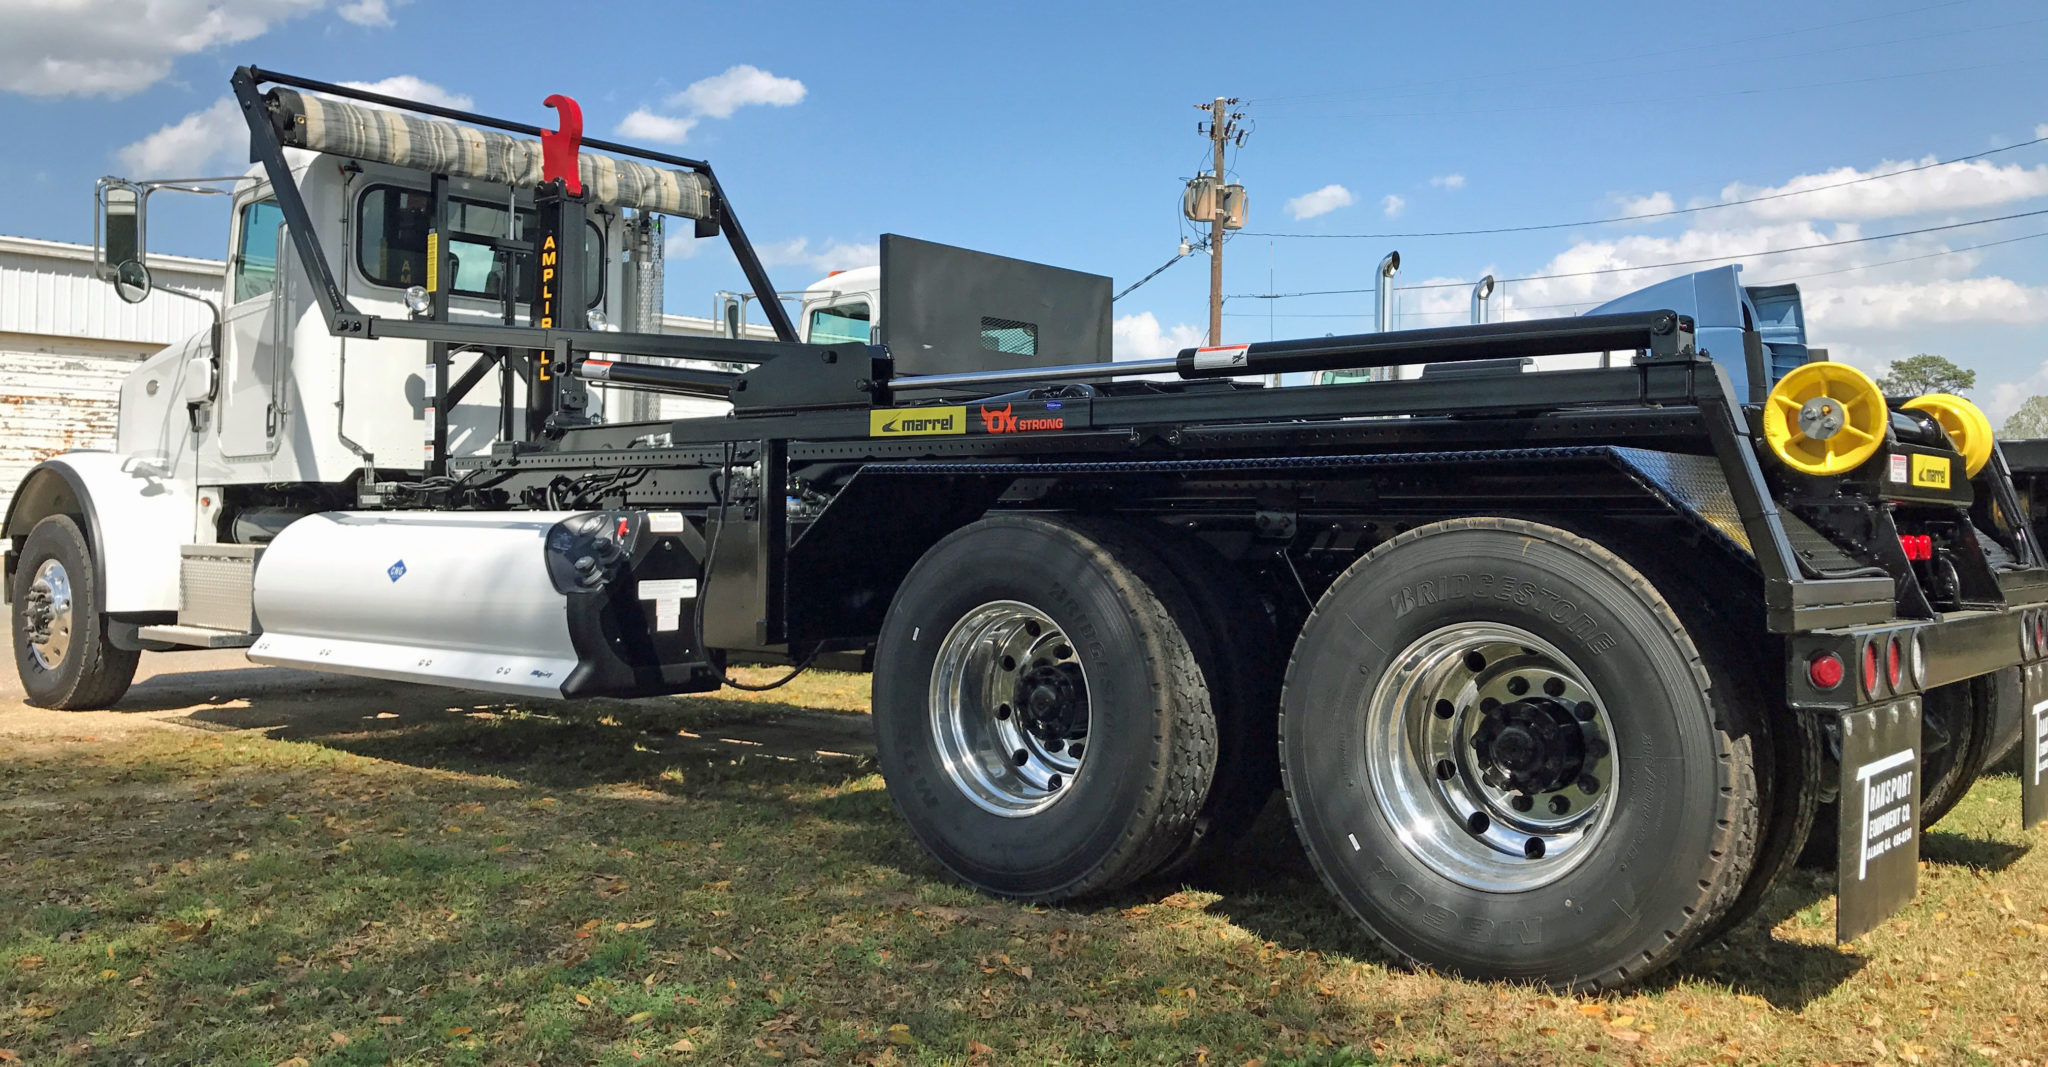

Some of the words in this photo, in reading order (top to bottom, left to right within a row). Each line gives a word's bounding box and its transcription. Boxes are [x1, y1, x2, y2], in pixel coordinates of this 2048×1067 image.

[539, 235, 556, 381] AMPLIRLL
[902, 414, 953, 432] marrel
[1019, 417, 1064, 431] STRONG
[1391, 573, 1617, 655] BRIDGESTONE
